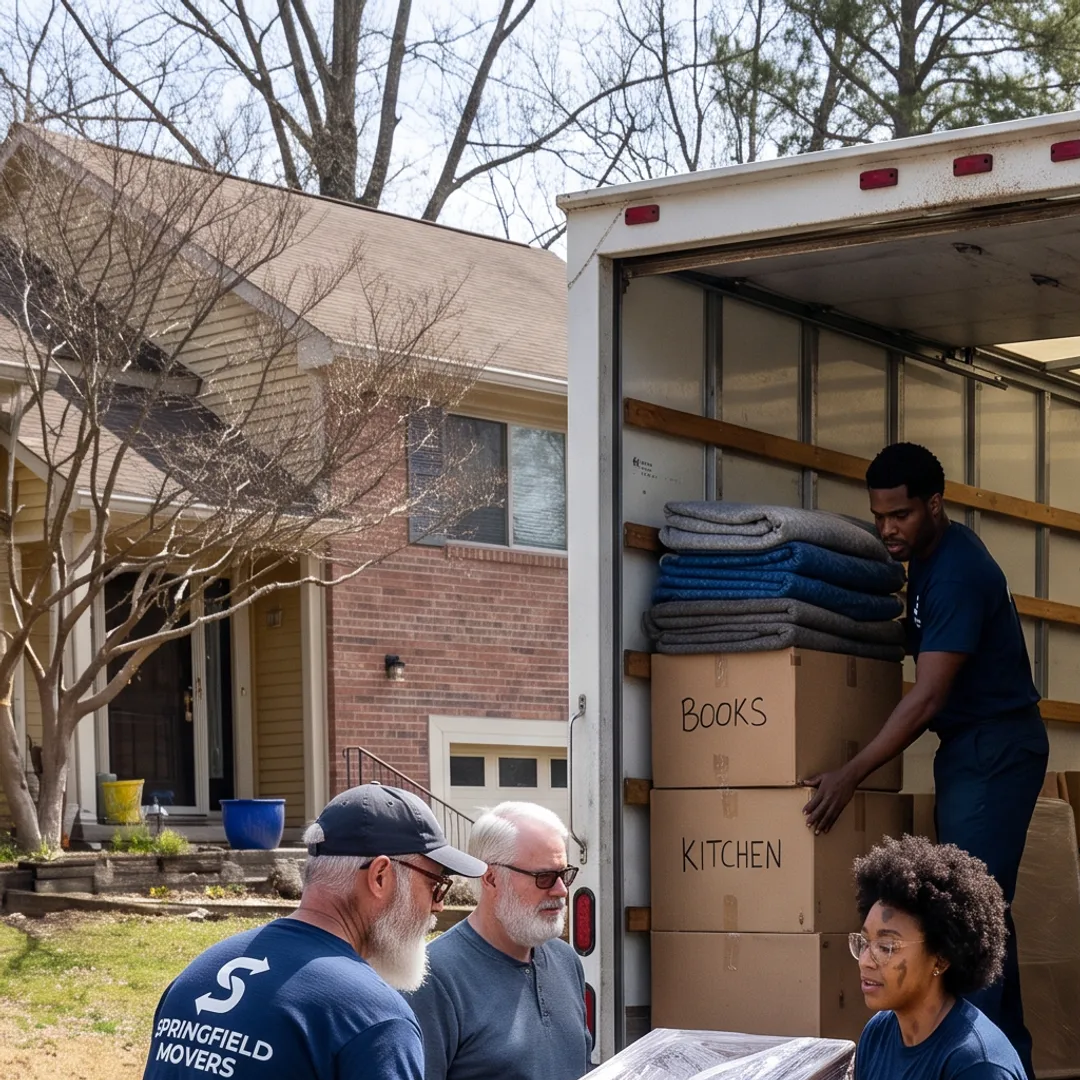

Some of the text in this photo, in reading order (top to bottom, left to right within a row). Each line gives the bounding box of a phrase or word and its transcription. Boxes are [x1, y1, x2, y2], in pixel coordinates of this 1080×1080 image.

[682, 697, 767, 732] BOOKS
[682, 836, 781, 872] KITCHEN
[155, 1018, 274, 1062] SPRINGFIELD
[155, 1041, 237, 1078] MOVERS
